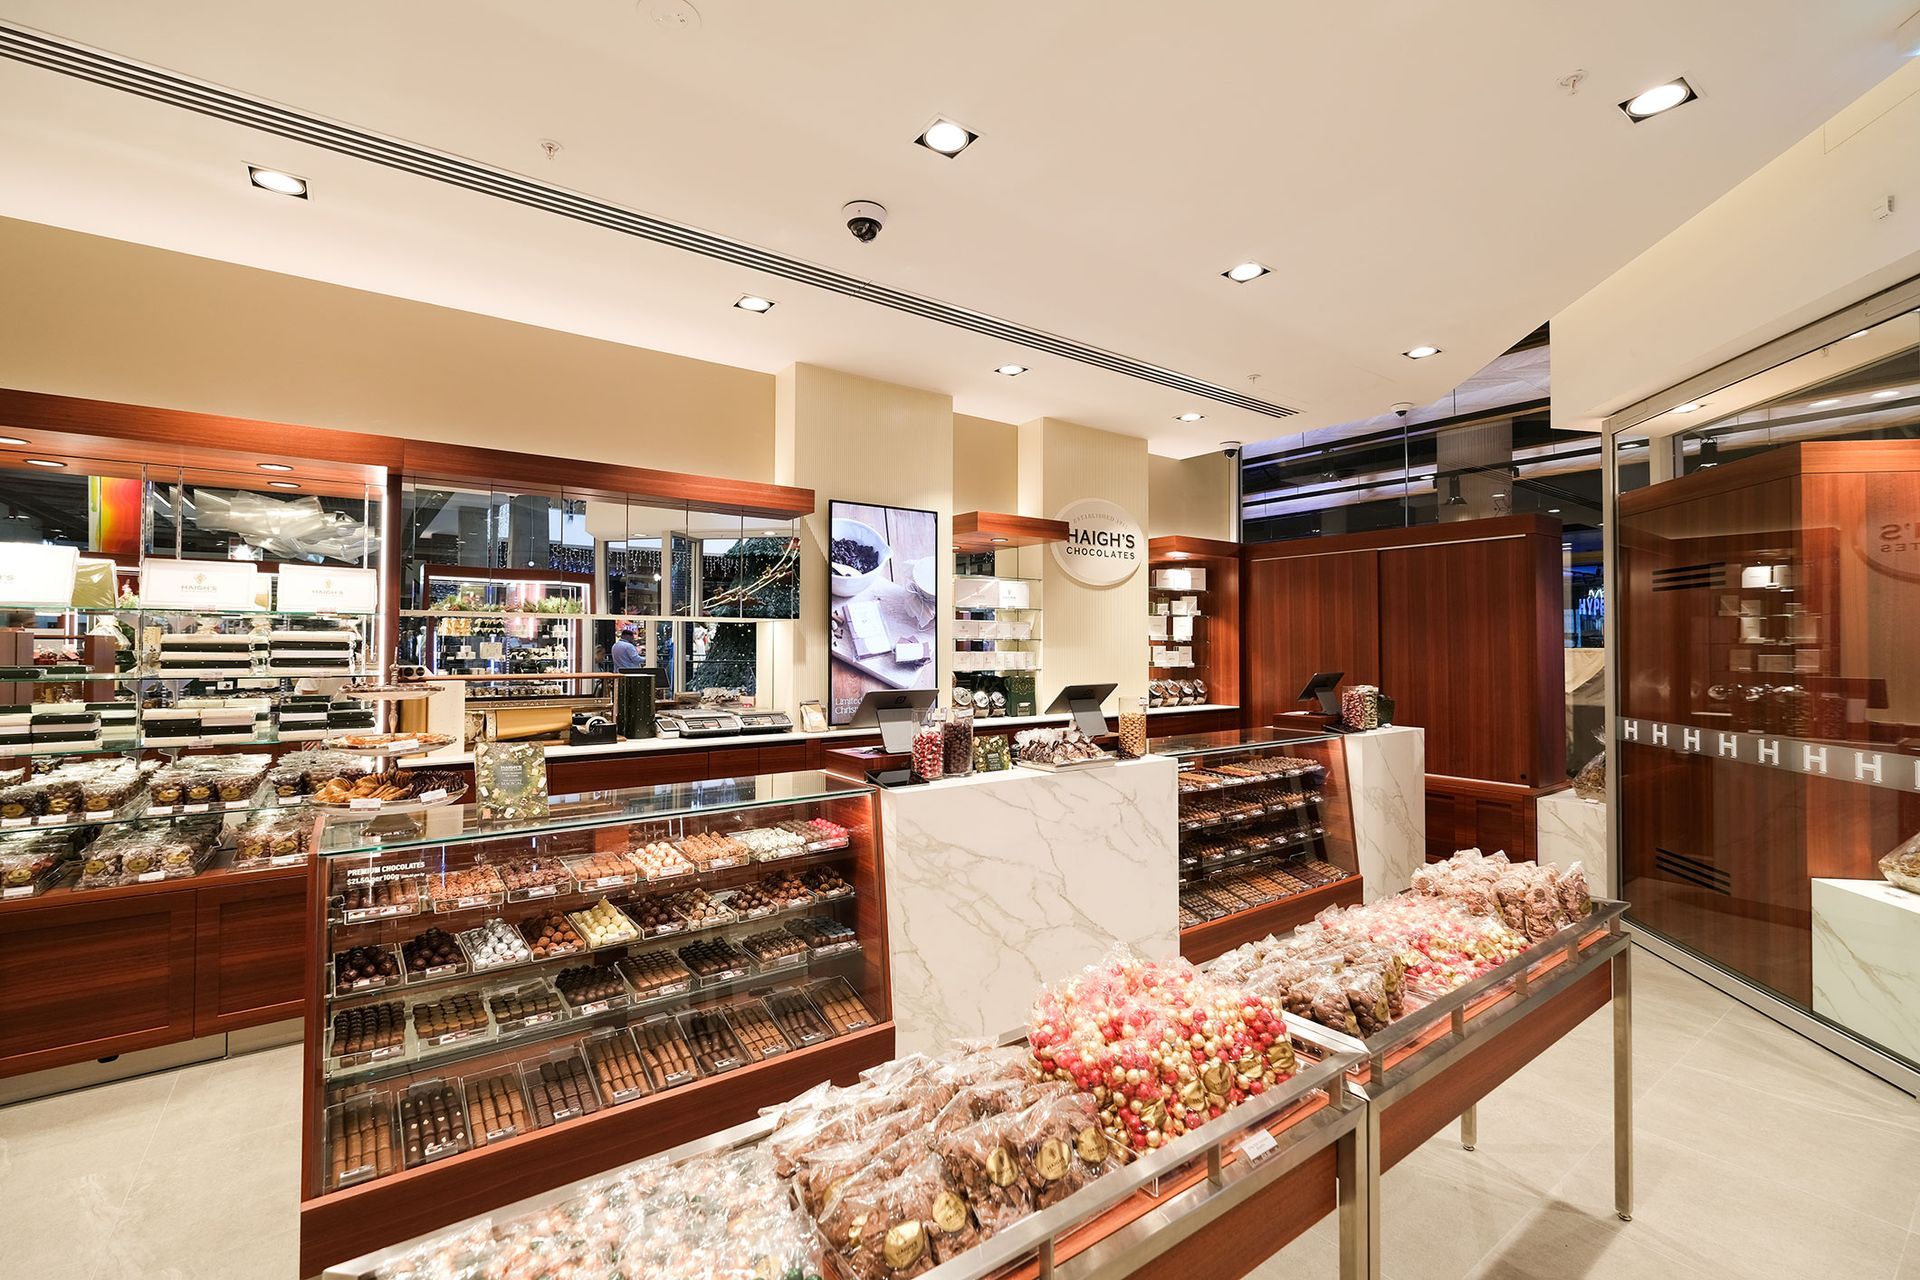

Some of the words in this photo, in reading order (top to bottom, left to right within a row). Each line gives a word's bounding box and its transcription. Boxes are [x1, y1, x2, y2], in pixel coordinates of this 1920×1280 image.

[1067, 529, 1135, 548] HAIGH'S
[1066, 546, 1135, 560] CHOCOLATES
[1624, 720, 1638, 740] H
[1652, 723, 1667, 746] H
[1683, 728, 1700, 752] H
[1718, 733, 1737, 758] H
[1758, 739, 1779, 765] H
[1803, 745, 1827, 774] H
[1855, 752, 1882, 783] H
[347, 867, 381, 876] PREMIUM
[382, 862, 425, 872] CHOCOLATES
[370, 875, 383, 886] per
[383, 873, 400, 881] 100g
